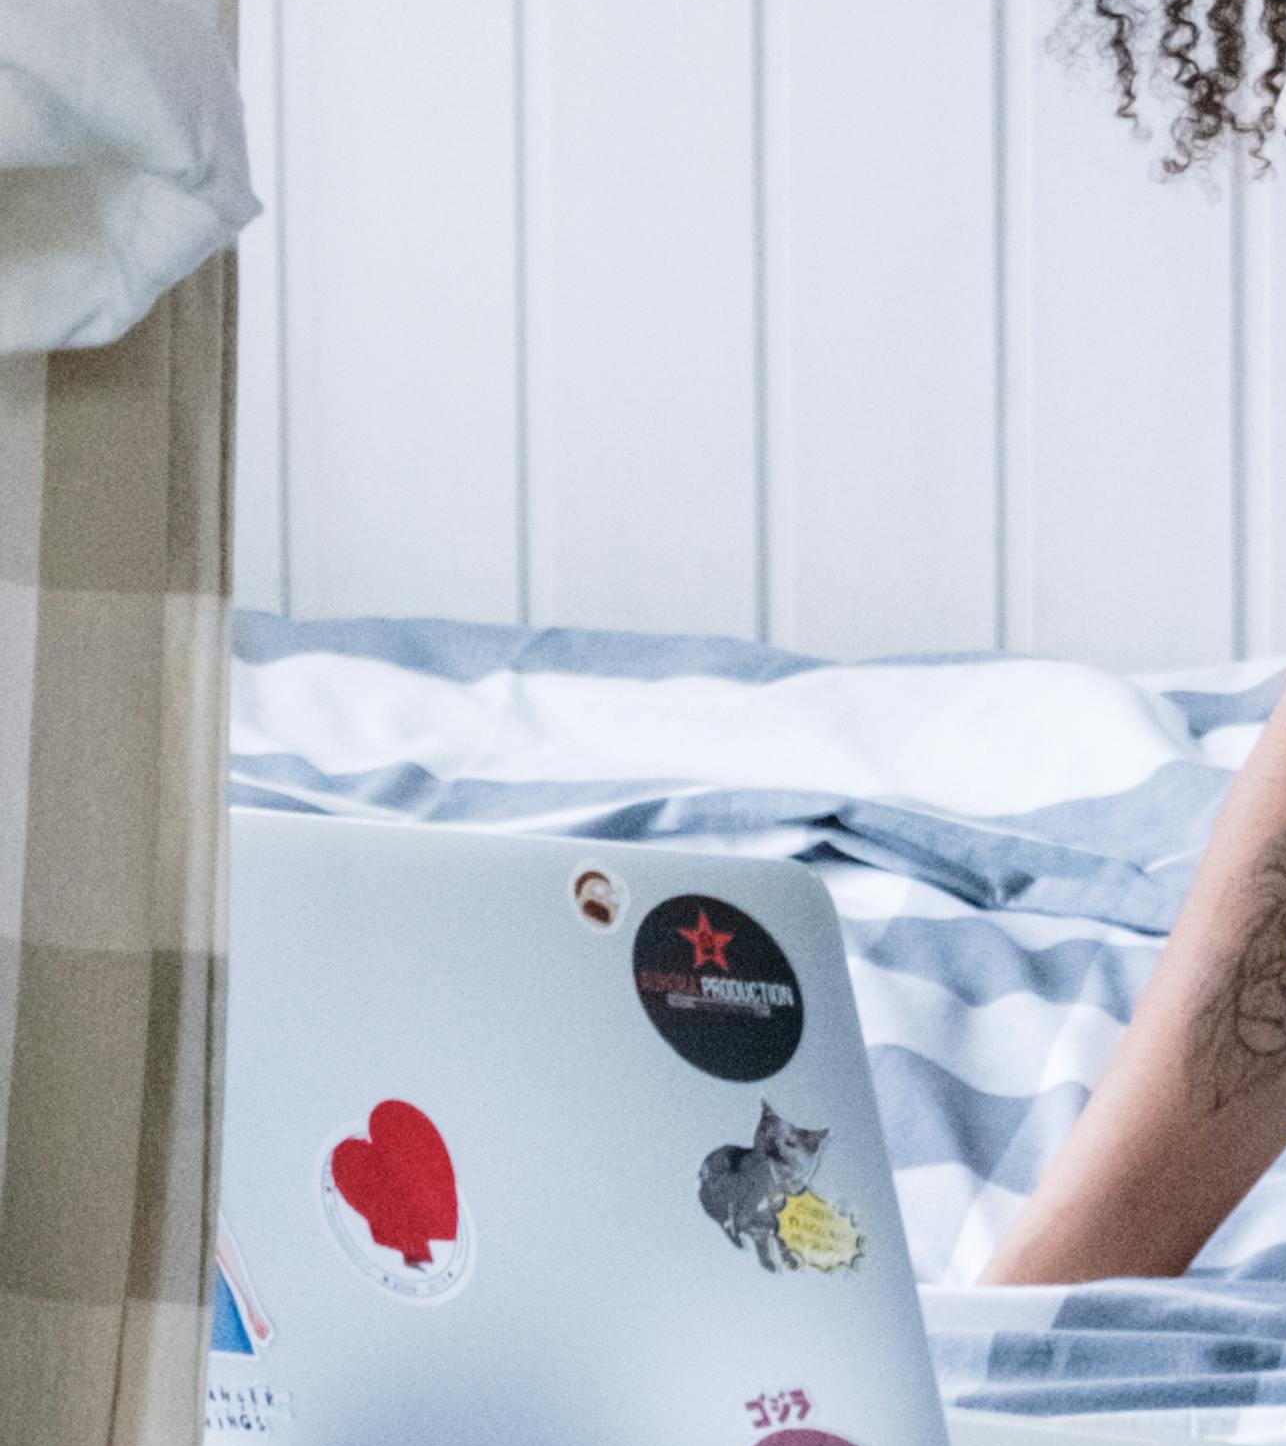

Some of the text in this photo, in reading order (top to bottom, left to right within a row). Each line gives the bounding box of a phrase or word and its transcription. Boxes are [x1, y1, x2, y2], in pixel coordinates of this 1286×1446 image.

[700, 975, 795, 1007] PRODUCTION
[745, 1389, 811, 1428] ゴジラ
